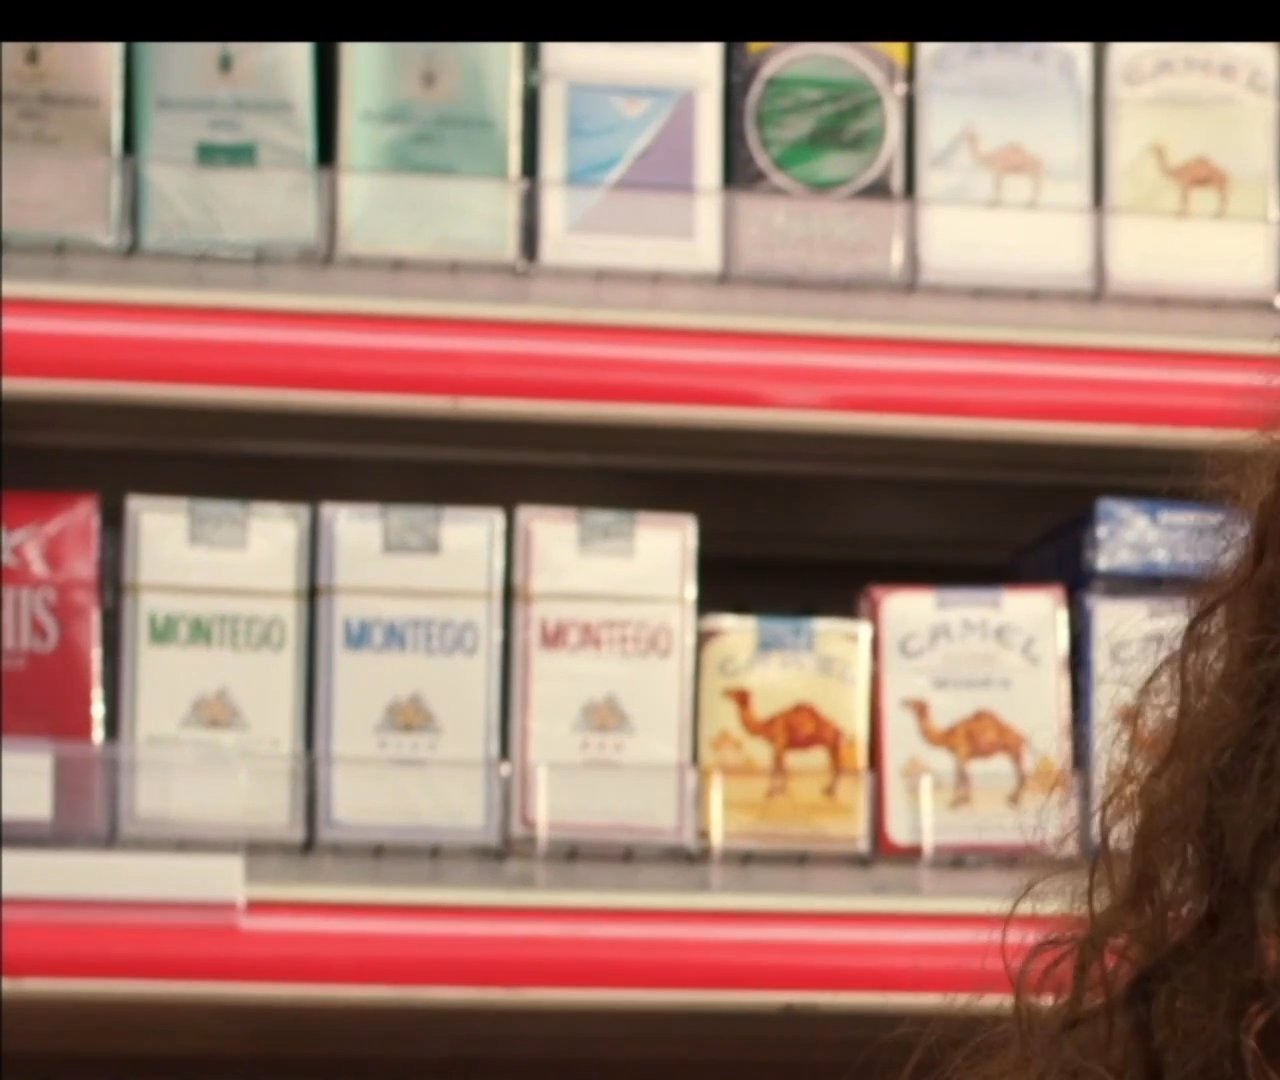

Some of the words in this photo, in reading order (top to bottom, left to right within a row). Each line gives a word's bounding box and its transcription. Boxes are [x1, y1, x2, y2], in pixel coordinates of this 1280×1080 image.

[148, 610, 287, 653] MONTEGO
[344, 615, 479, 658] MONTEGO
[538, 617, 673, 660] MONTEGO
[898, 618, 1044, 666] CAMEL
